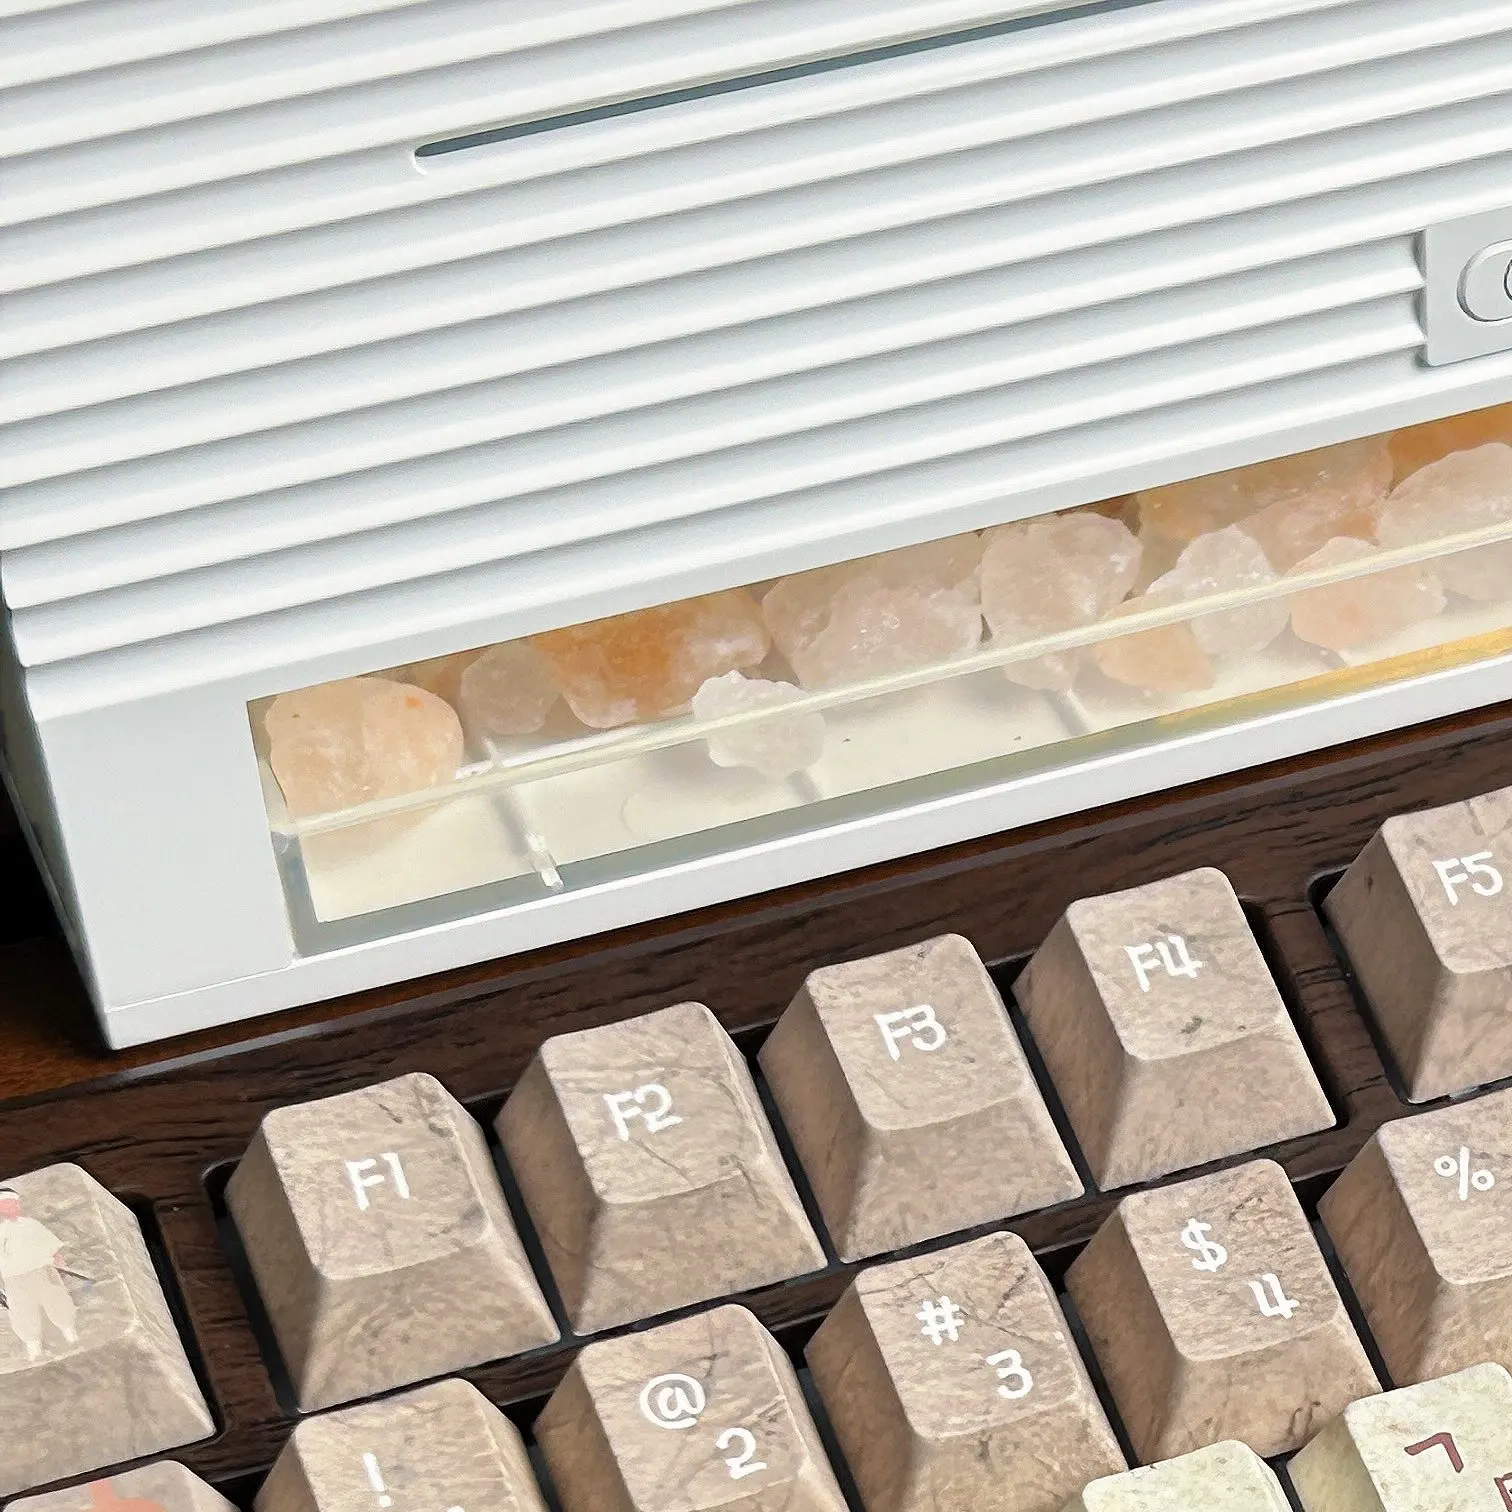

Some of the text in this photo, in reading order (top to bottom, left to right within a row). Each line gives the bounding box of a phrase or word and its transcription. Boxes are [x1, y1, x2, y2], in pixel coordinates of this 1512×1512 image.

[1432, 851, 1503, 905] F5
[1124, 935, 1202, 991] F4
[873, 1005, 948, 1060] F3
[604, 1083, 682, 1141] F2
[345, 1152, 410, 1210] F1
[1434, 1146, 1495, 1200] %
[1180, 1218, 1228, 1272] $
[915, 1296, 964, 1345] #
[1248, 1273, 1300, 1318] 4
[986, 1350, 1033, 1398] 3
[639, 1373, 705, 1430] @
[363, 1452, 393, 1508] !
[715, 1427, 767, 1479] 2
